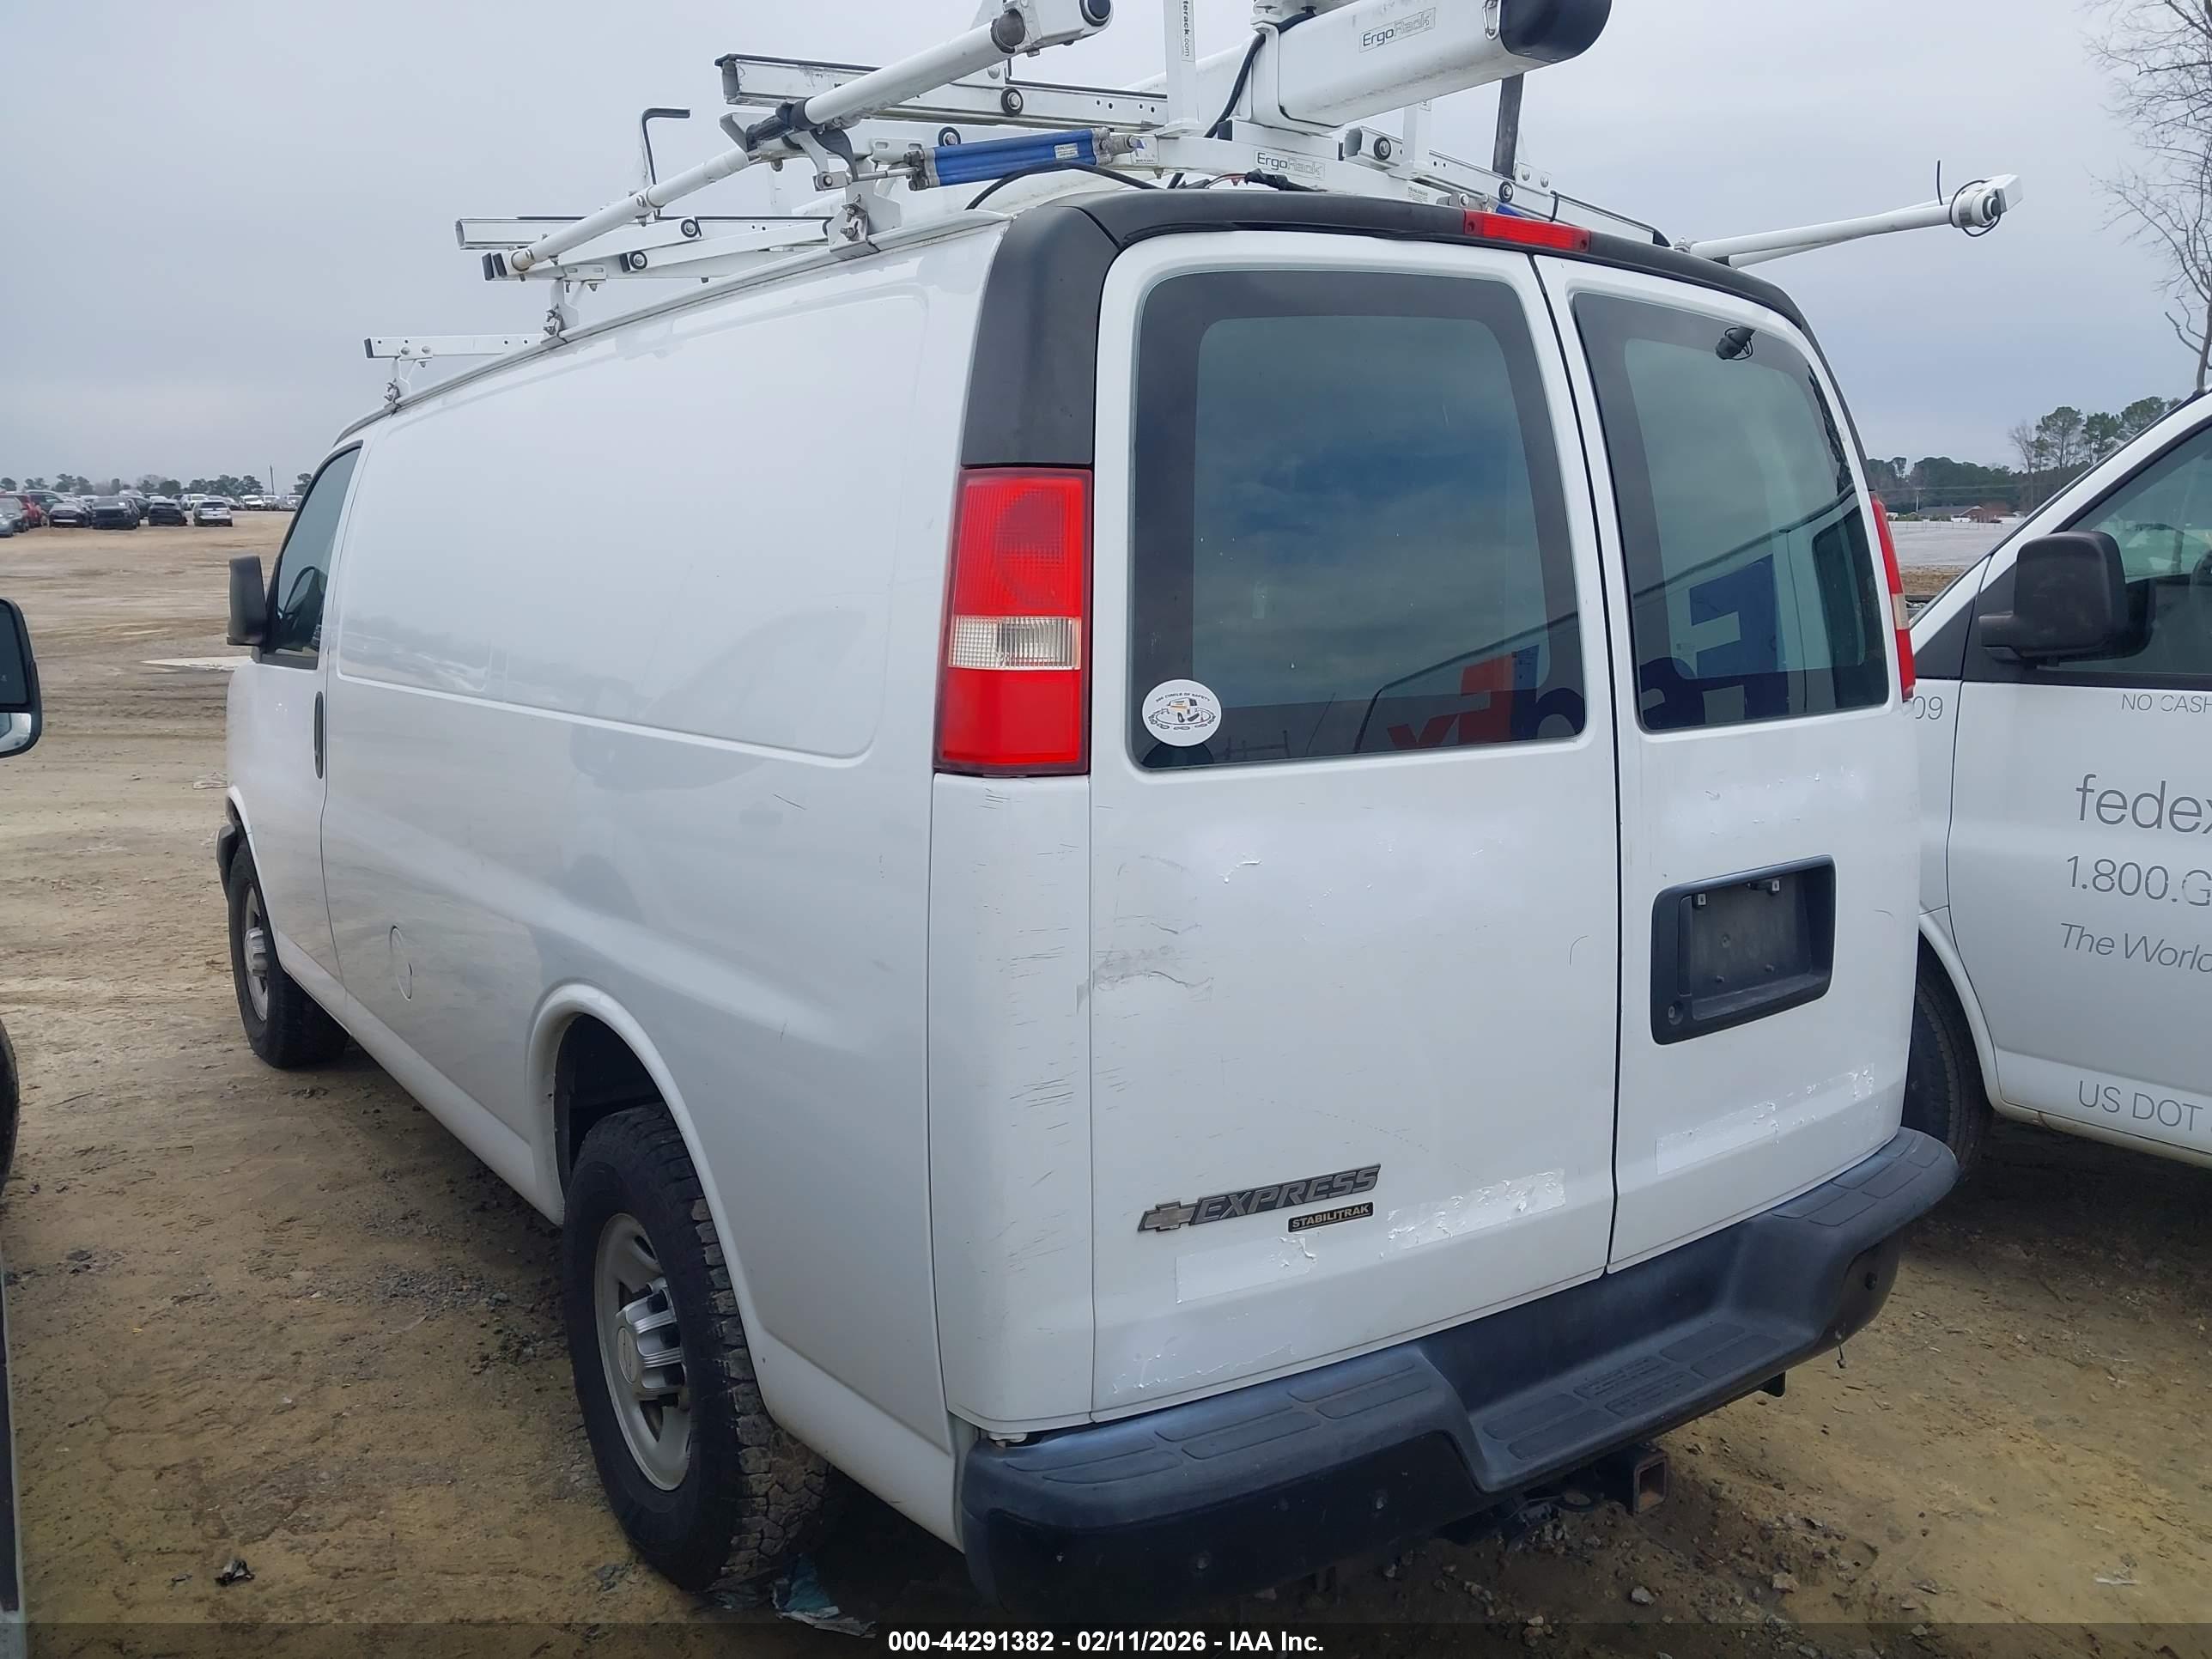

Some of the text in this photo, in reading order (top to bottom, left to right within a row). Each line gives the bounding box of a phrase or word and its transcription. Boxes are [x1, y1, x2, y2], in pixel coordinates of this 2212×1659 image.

[2121, 693, 2153, 712] NO
[2061, 922, 2115, 956] The
[2078, 1080, 2203, 1131] US DOT
[1194, 1166, 1379, 1224] EXPRESS
[1291, 1205, 1370, 1228] STABILITRAK
